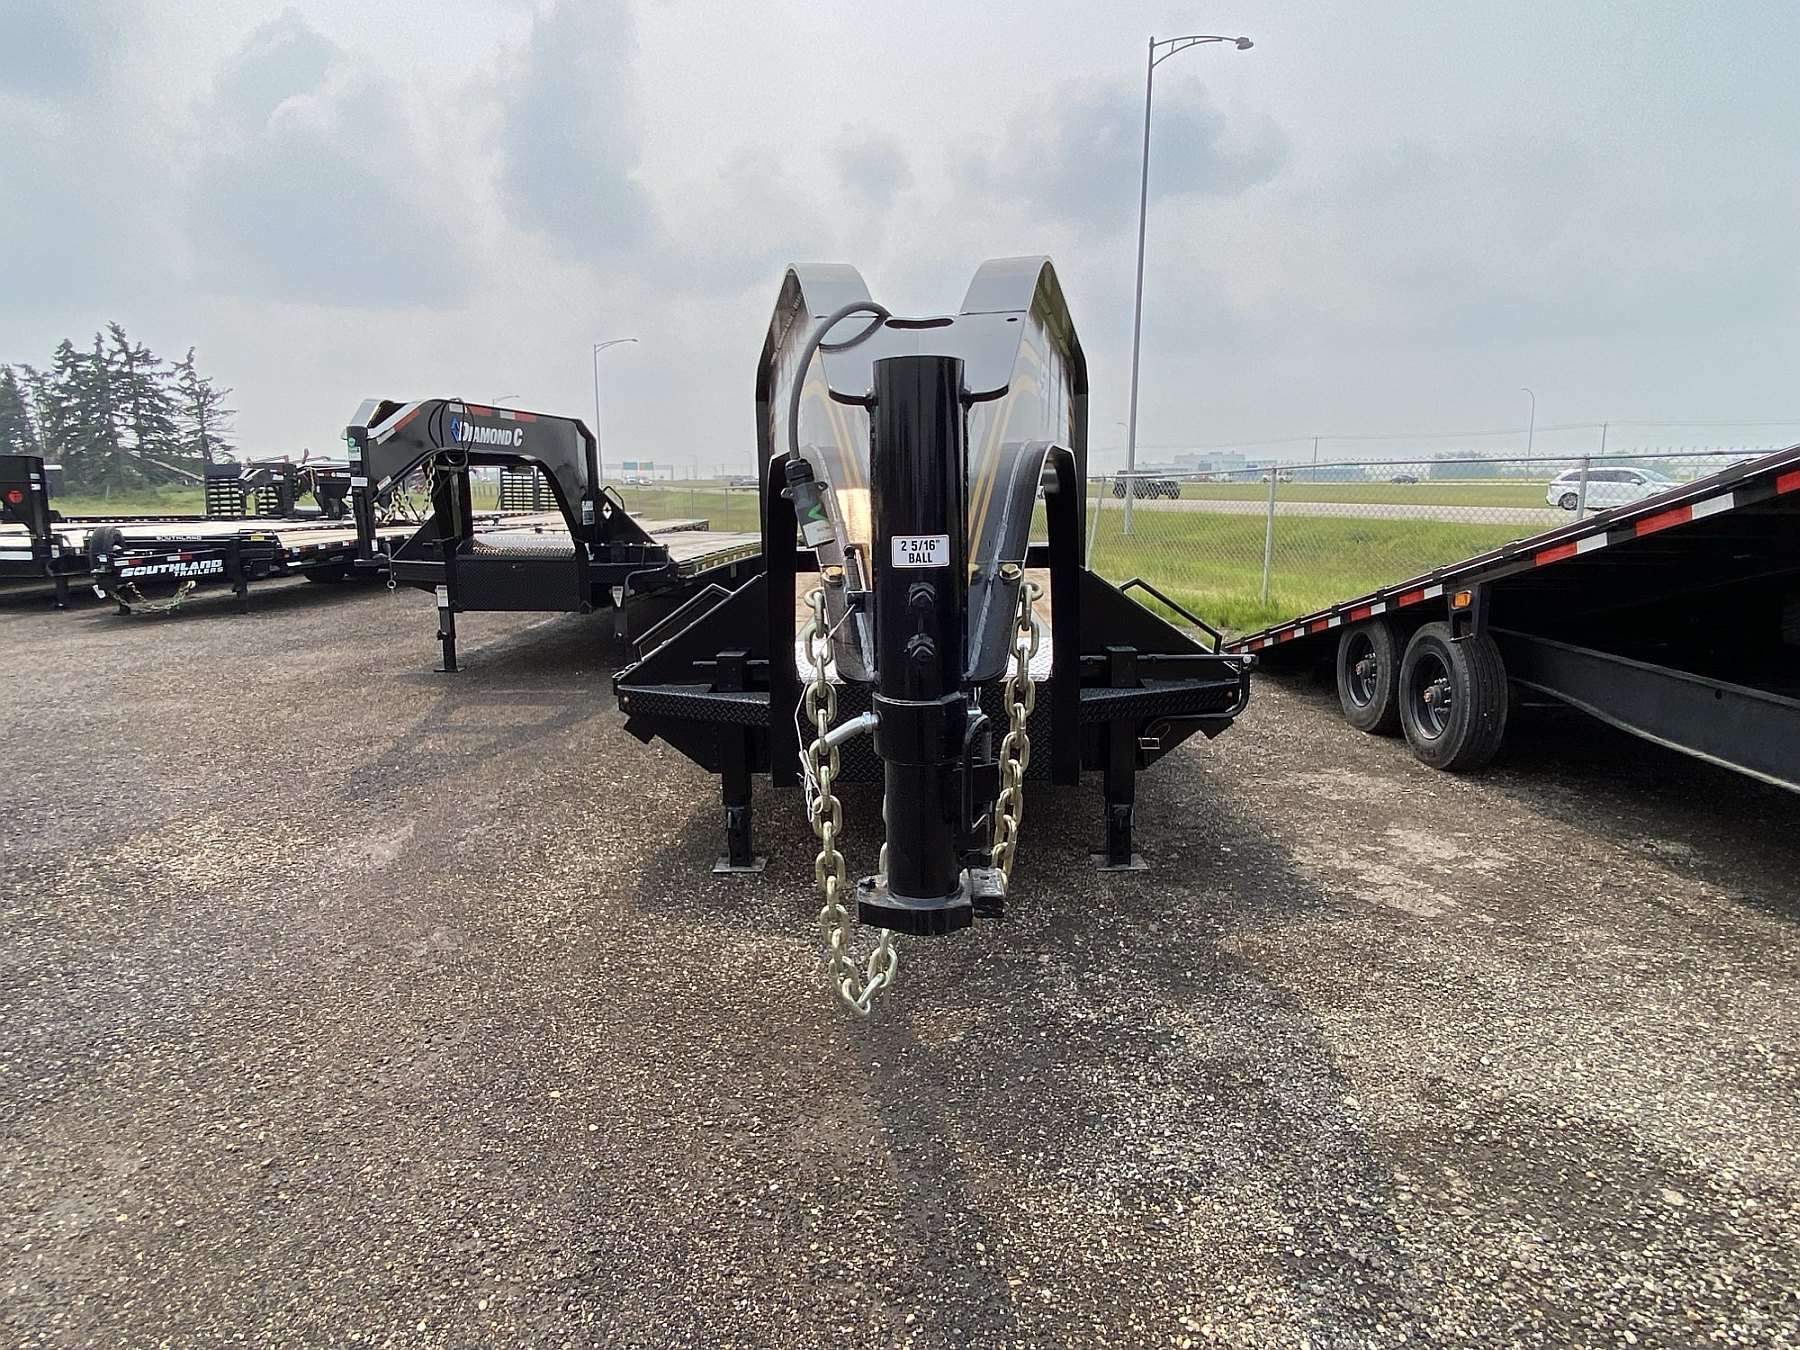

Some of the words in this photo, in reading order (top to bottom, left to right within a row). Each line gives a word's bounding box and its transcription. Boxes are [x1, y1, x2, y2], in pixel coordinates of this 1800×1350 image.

[458, 421, 512, 446] DIAMOND
[513, 428, 523, 447] C
[901, 540, 907, 552] 2
[911, 539, 940, 552] 5/16"
[908, 552, 933, 564] BALL
[120, 559, 223, 577] SOUTHLAND
[174, 566, 224, 577] TRAILERS
